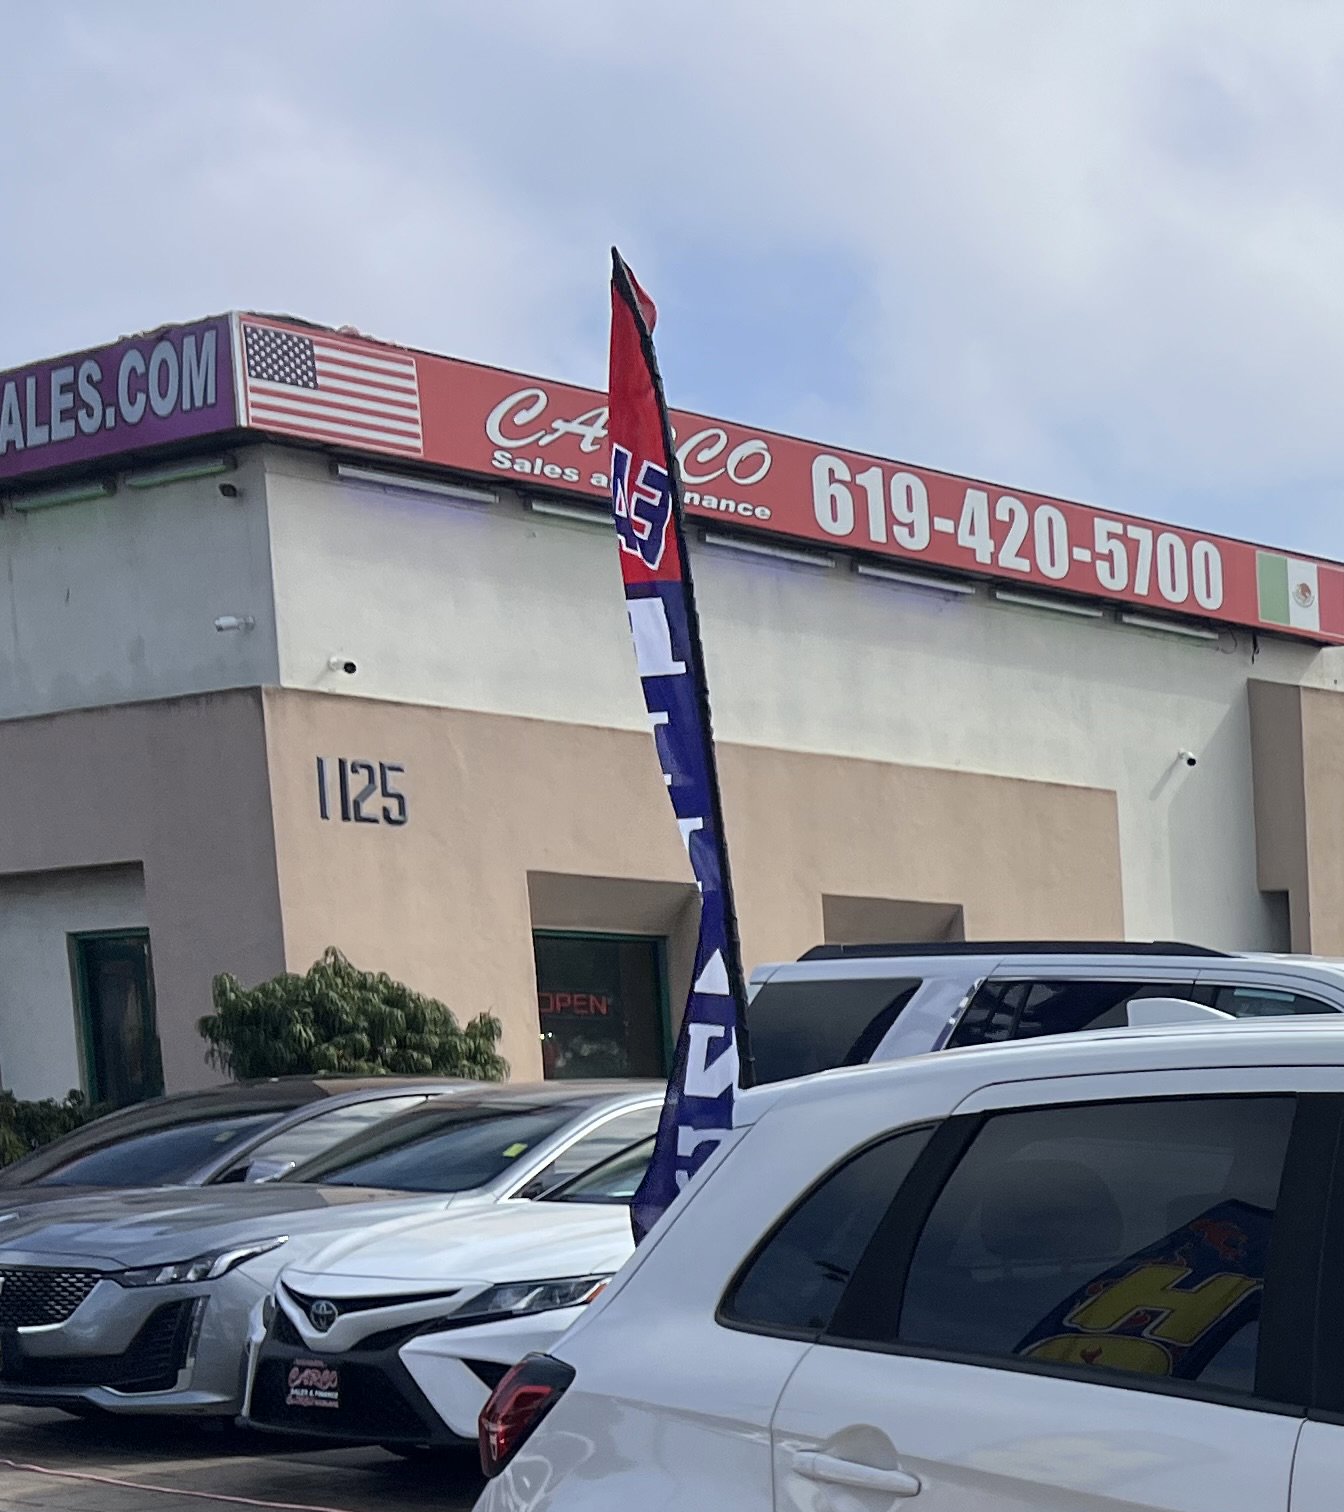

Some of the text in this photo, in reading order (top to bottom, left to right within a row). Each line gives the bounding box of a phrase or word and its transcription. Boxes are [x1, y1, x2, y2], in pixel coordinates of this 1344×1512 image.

[0, 329, 218, 454] ALES.COM
[485, 387, 773, 486] CACO
[491, 449, 581, 482] Sales
[683, 490, 772, 520] nance
[811, 453, 1224, 611] 619-420-5700
[316, 755, 410, 827] 1125
